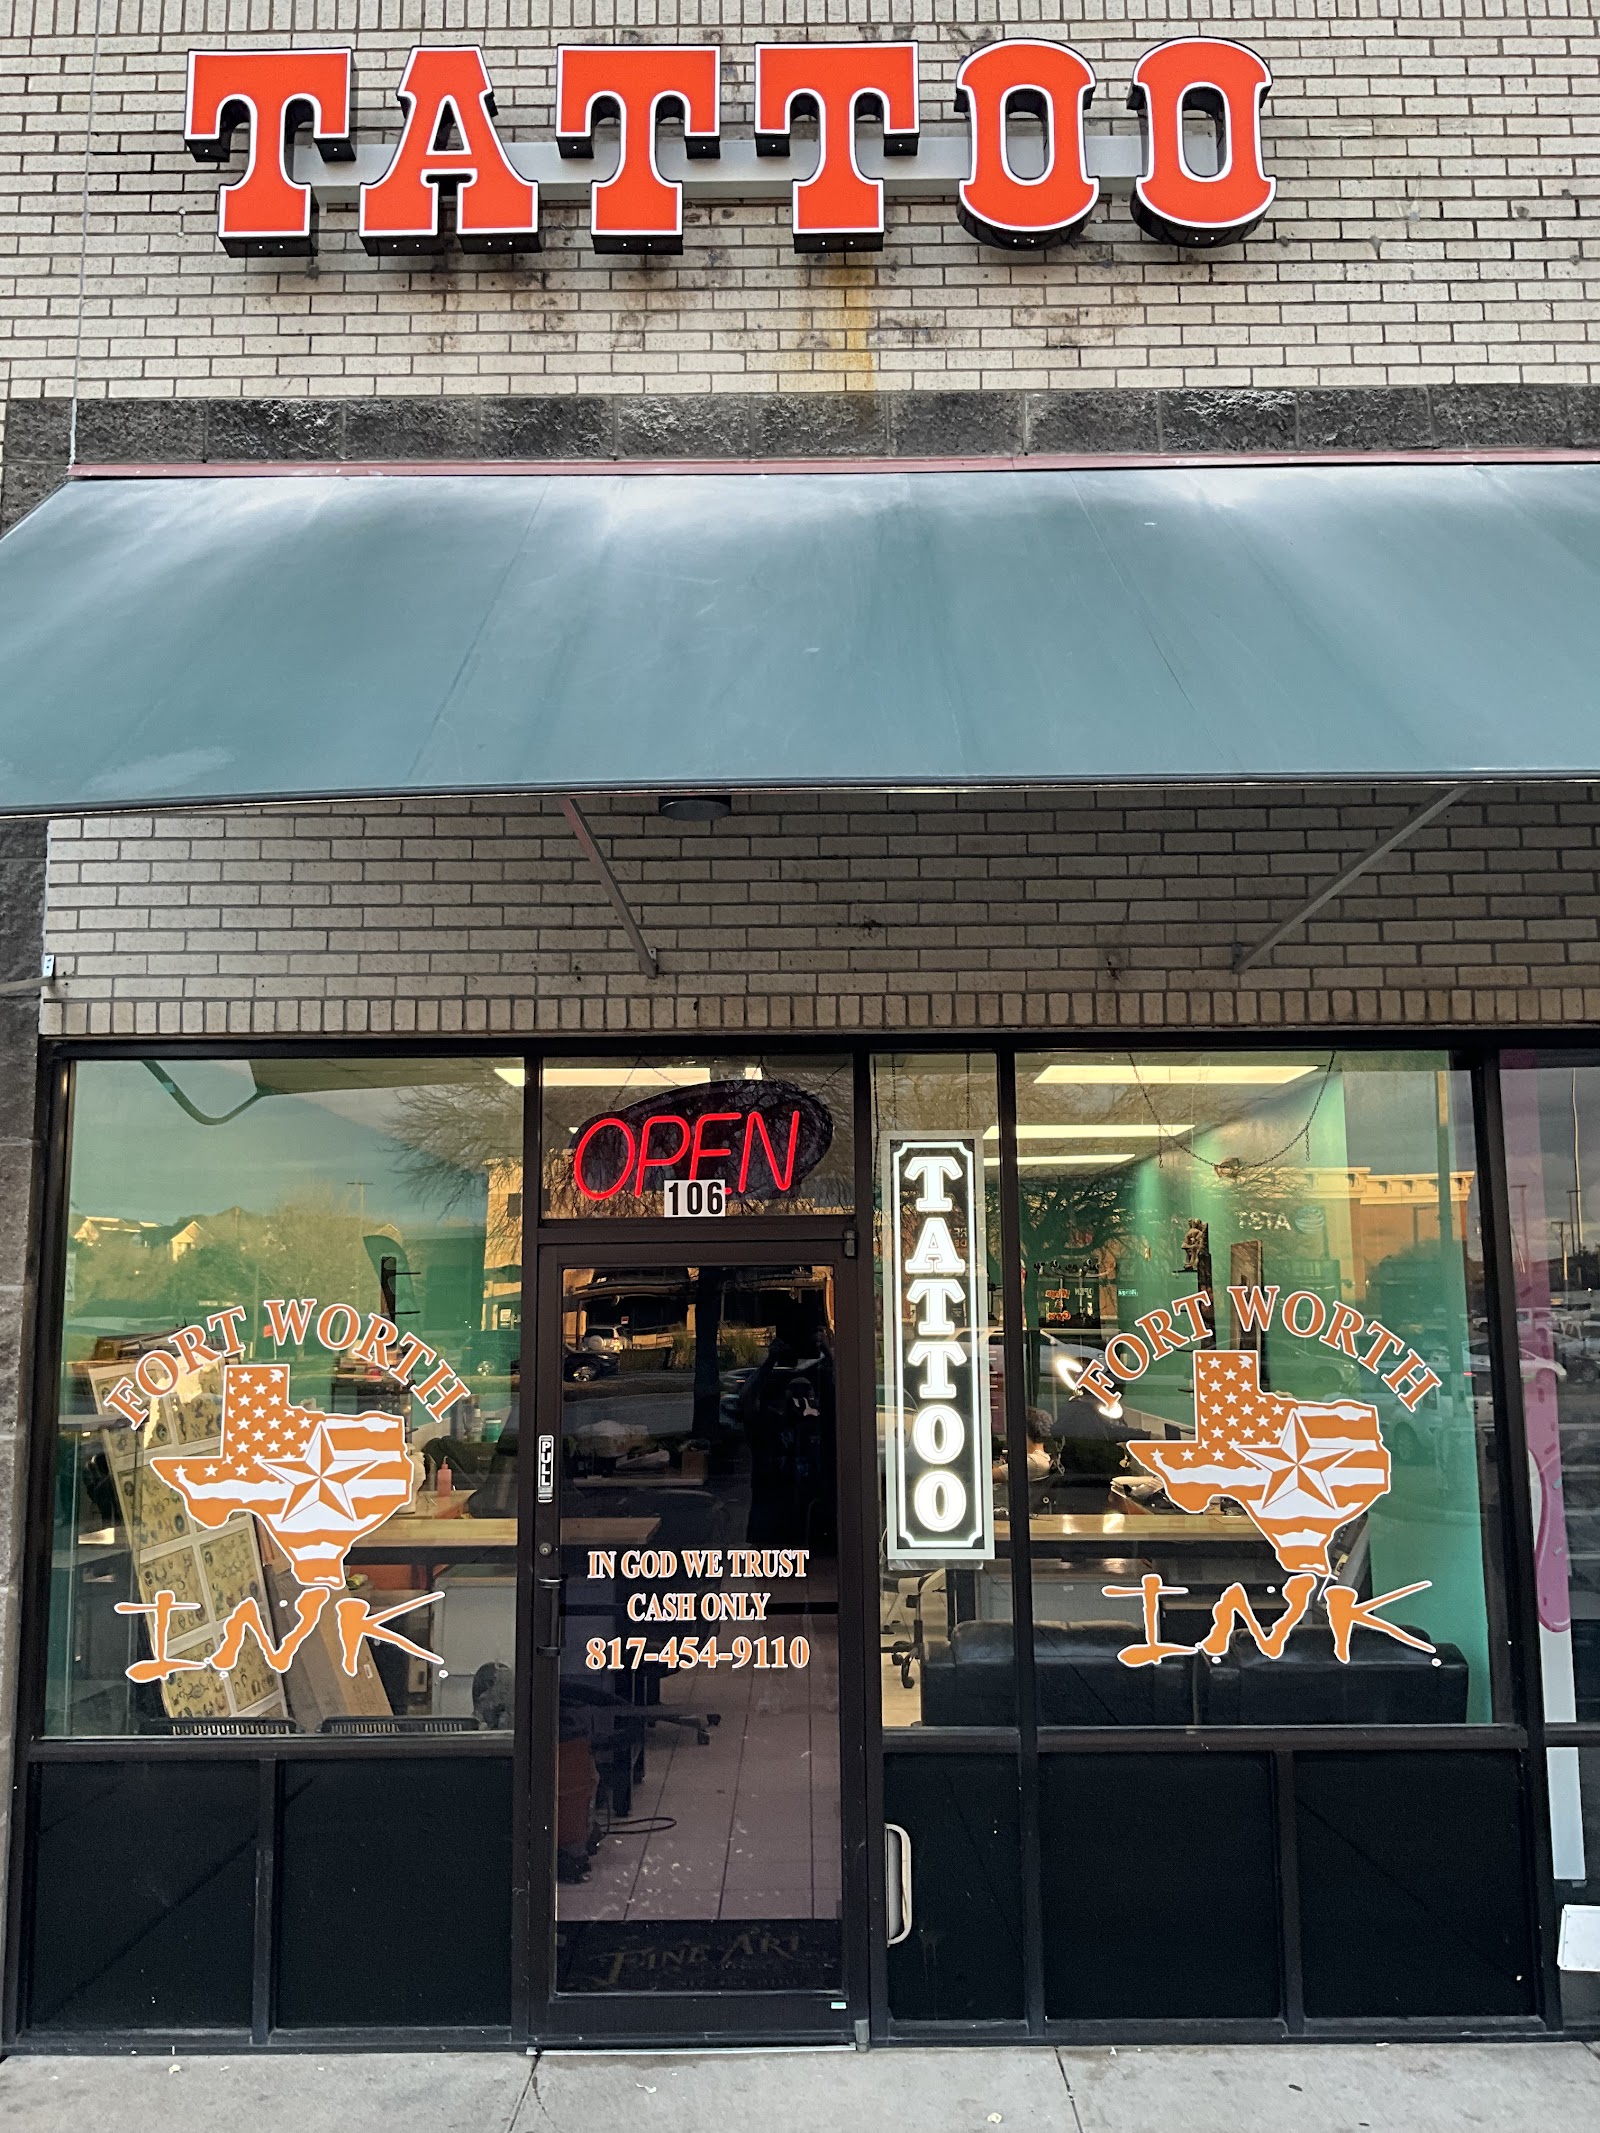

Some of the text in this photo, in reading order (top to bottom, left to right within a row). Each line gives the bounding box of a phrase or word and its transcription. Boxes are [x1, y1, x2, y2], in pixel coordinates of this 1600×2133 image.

[184, 37, 1278, 243] TATTOO
[572, 1109, 801, 1201] OPEN
[667, 1181, 725, 1217] 106
[104, 1298, 472, 1431] FORT WORTH
[903, 1155, 969, 1534] TATTOO
[1076, 1285, 1443, 1414] FORT WORTH
[541, 1441, 551, 1486] PULL
[587, 1549, 810, 1579] IN GOD WE TRUST
[627, 1592, 771, 1622] CASH ONLY
[114, 1585, 447, 1682] INK
[585, 1635, 811, 1671] 817-454-9110
[1101, 1572, 1438, 1667] INK
